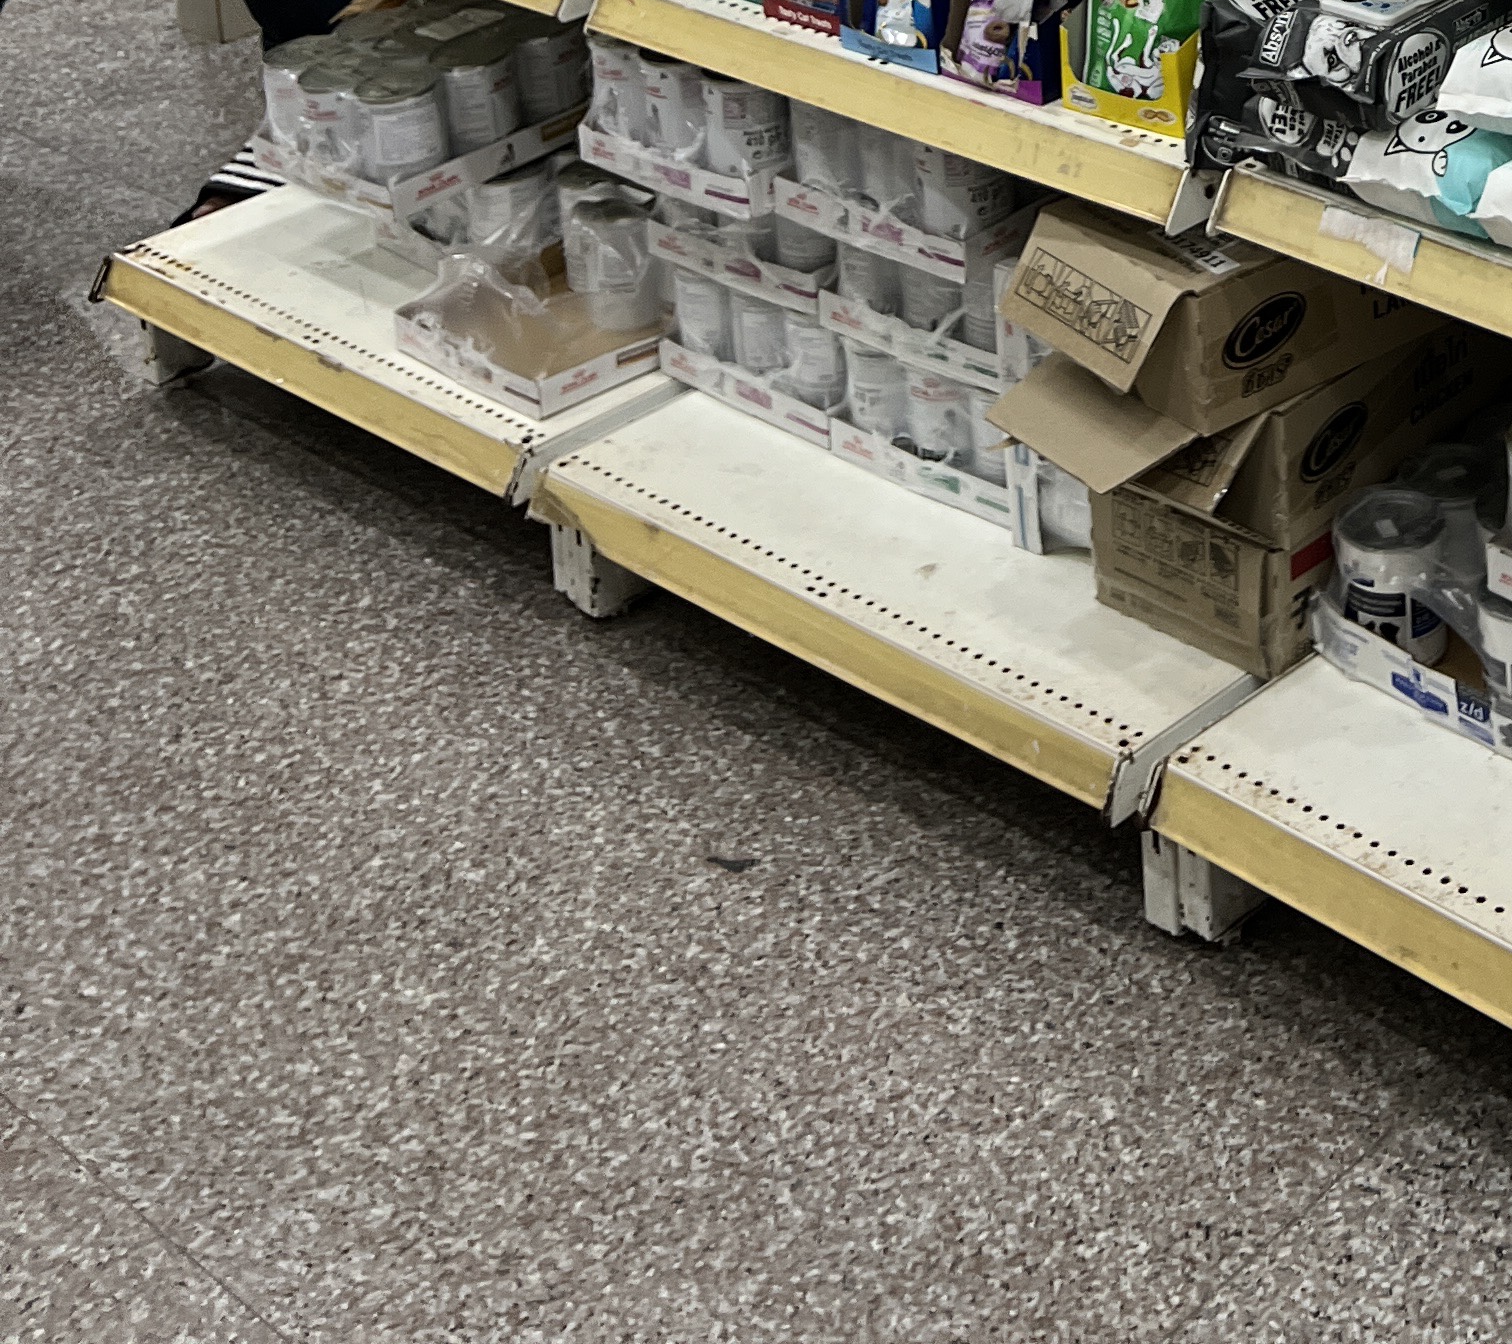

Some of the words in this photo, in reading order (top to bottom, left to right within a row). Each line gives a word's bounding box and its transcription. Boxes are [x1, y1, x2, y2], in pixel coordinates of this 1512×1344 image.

[1398, 42, 1434, 72] Alcohol
[1401, 56, 1438, 88] Paraben
[1397, 73, 1442, 111] FREE!
[1457, 697, 1485, 721] z/d
